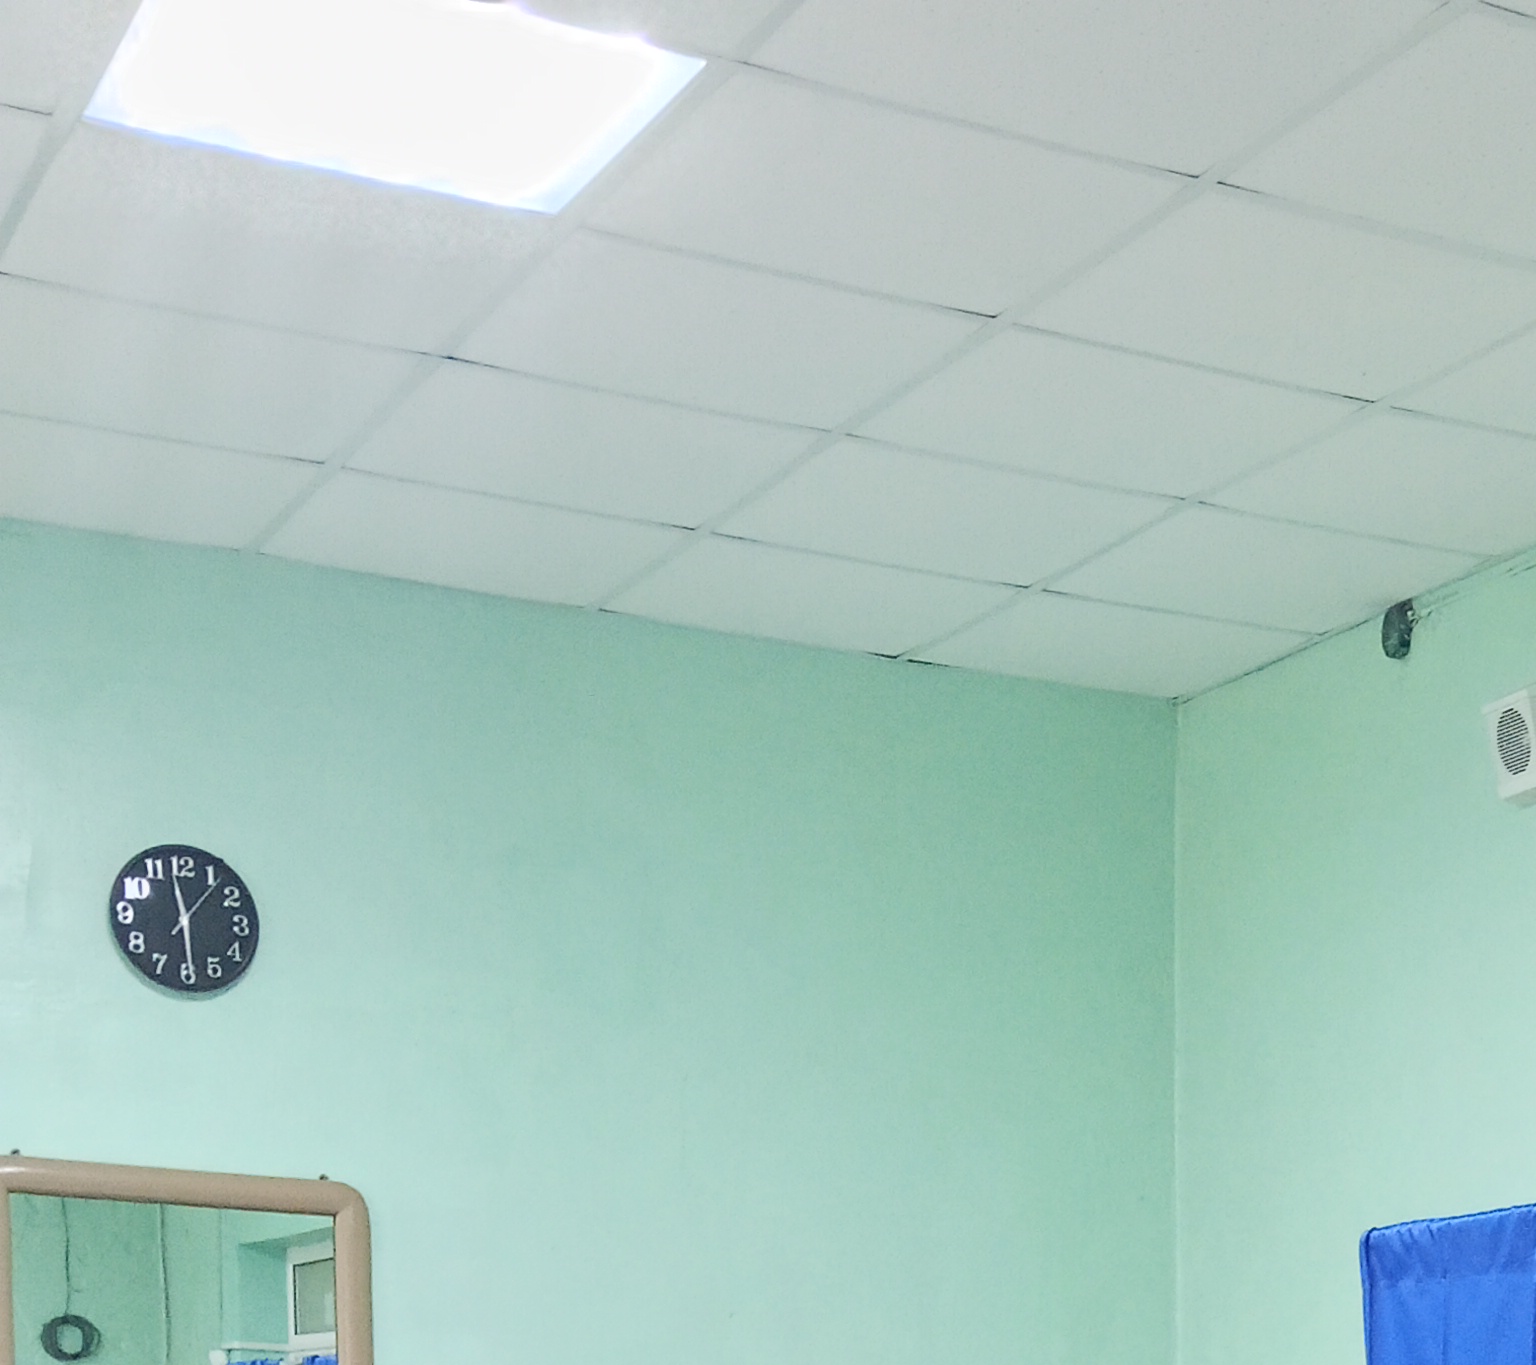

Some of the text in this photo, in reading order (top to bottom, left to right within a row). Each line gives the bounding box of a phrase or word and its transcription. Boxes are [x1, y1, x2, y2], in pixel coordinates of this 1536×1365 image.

[145, 858, 165, 880] 11
[170, 855, 196, 878] 12
[205, 865, 216, 886] 1
[123, 876, 150, 900] 10
[222, 886, 242, 908] 2
[116, 901, 135, 925] 9
[232, 914, 250, 937] 3
[128, 931, 146, 954] 8
[226, 941, 243, 963] 4
[152, 953, 168, 975] 7
[206, 956, 223, 979] 5
